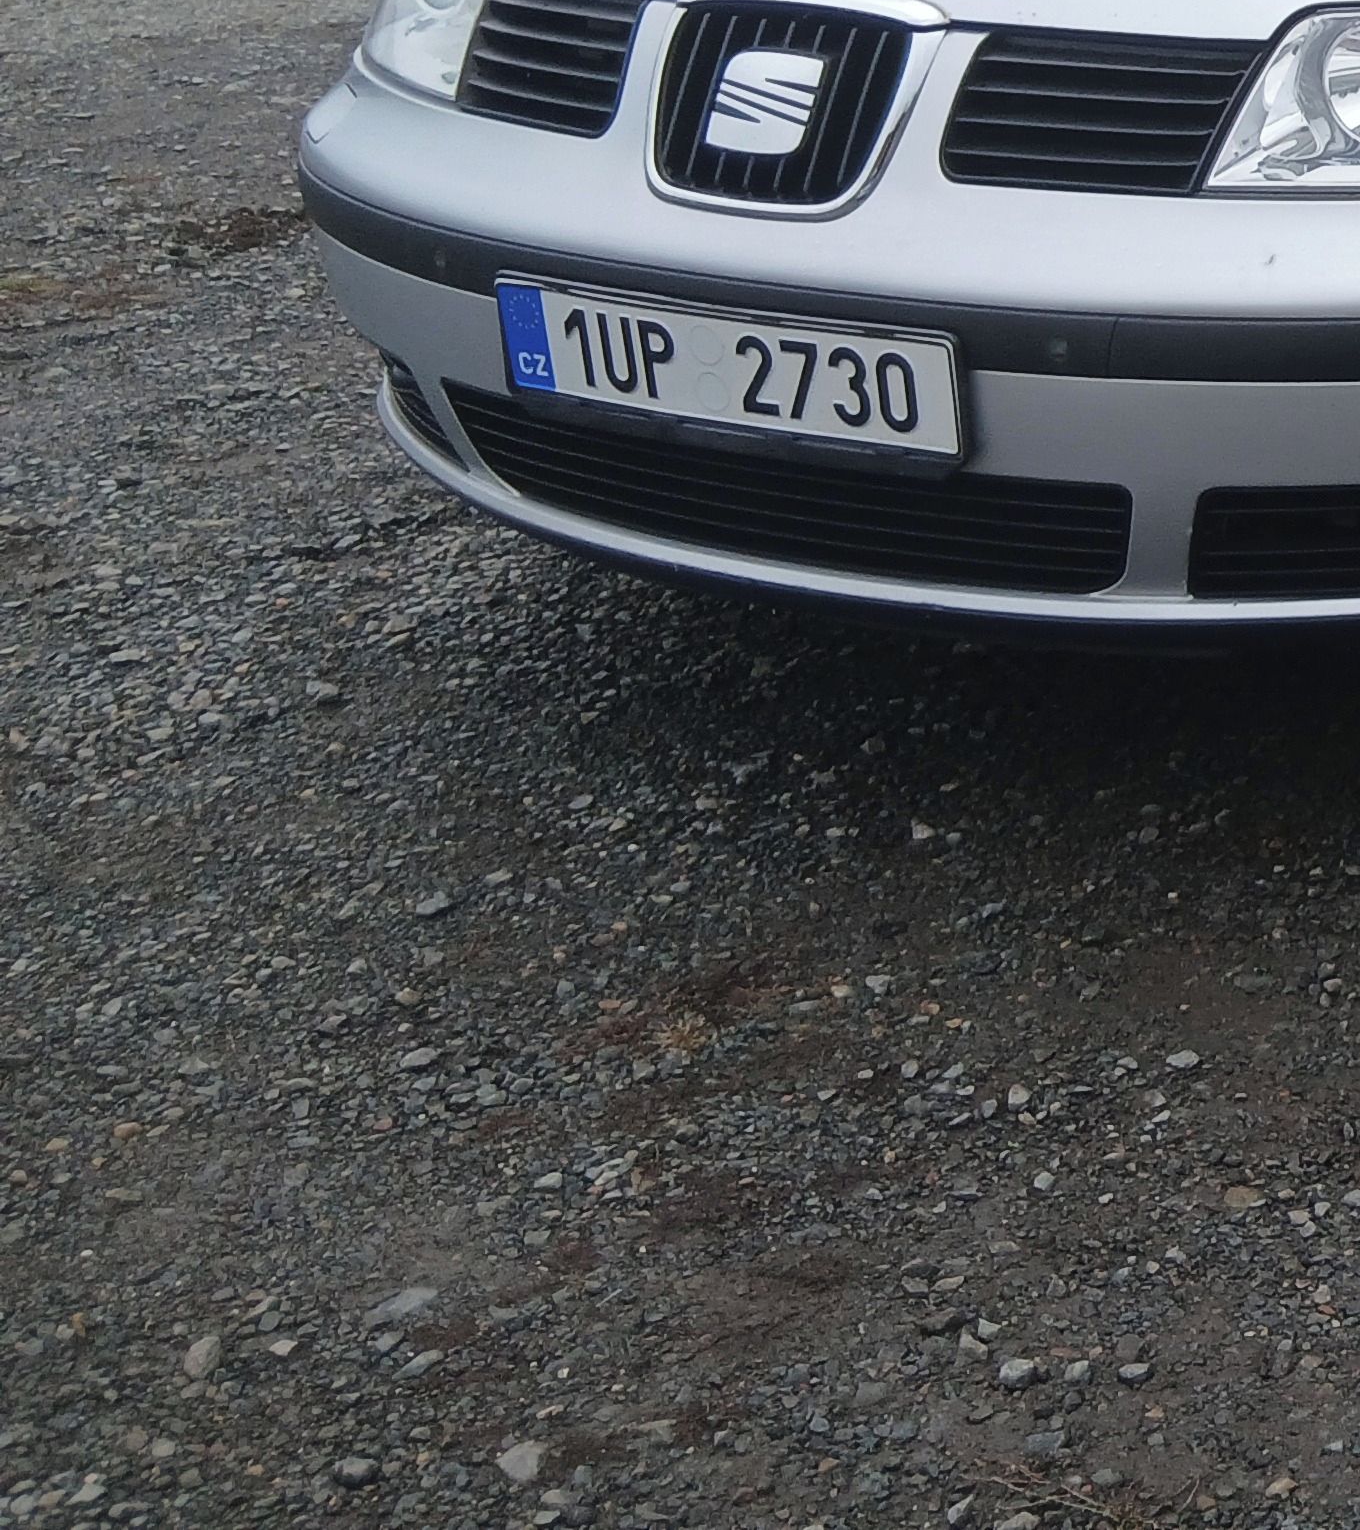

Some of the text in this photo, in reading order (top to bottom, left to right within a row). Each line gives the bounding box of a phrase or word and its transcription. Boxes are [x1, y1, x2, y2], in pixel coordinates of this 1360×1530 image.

[518, 351, 549, 379] CZ
[564, 307, 919, 433] 1UP 2730
